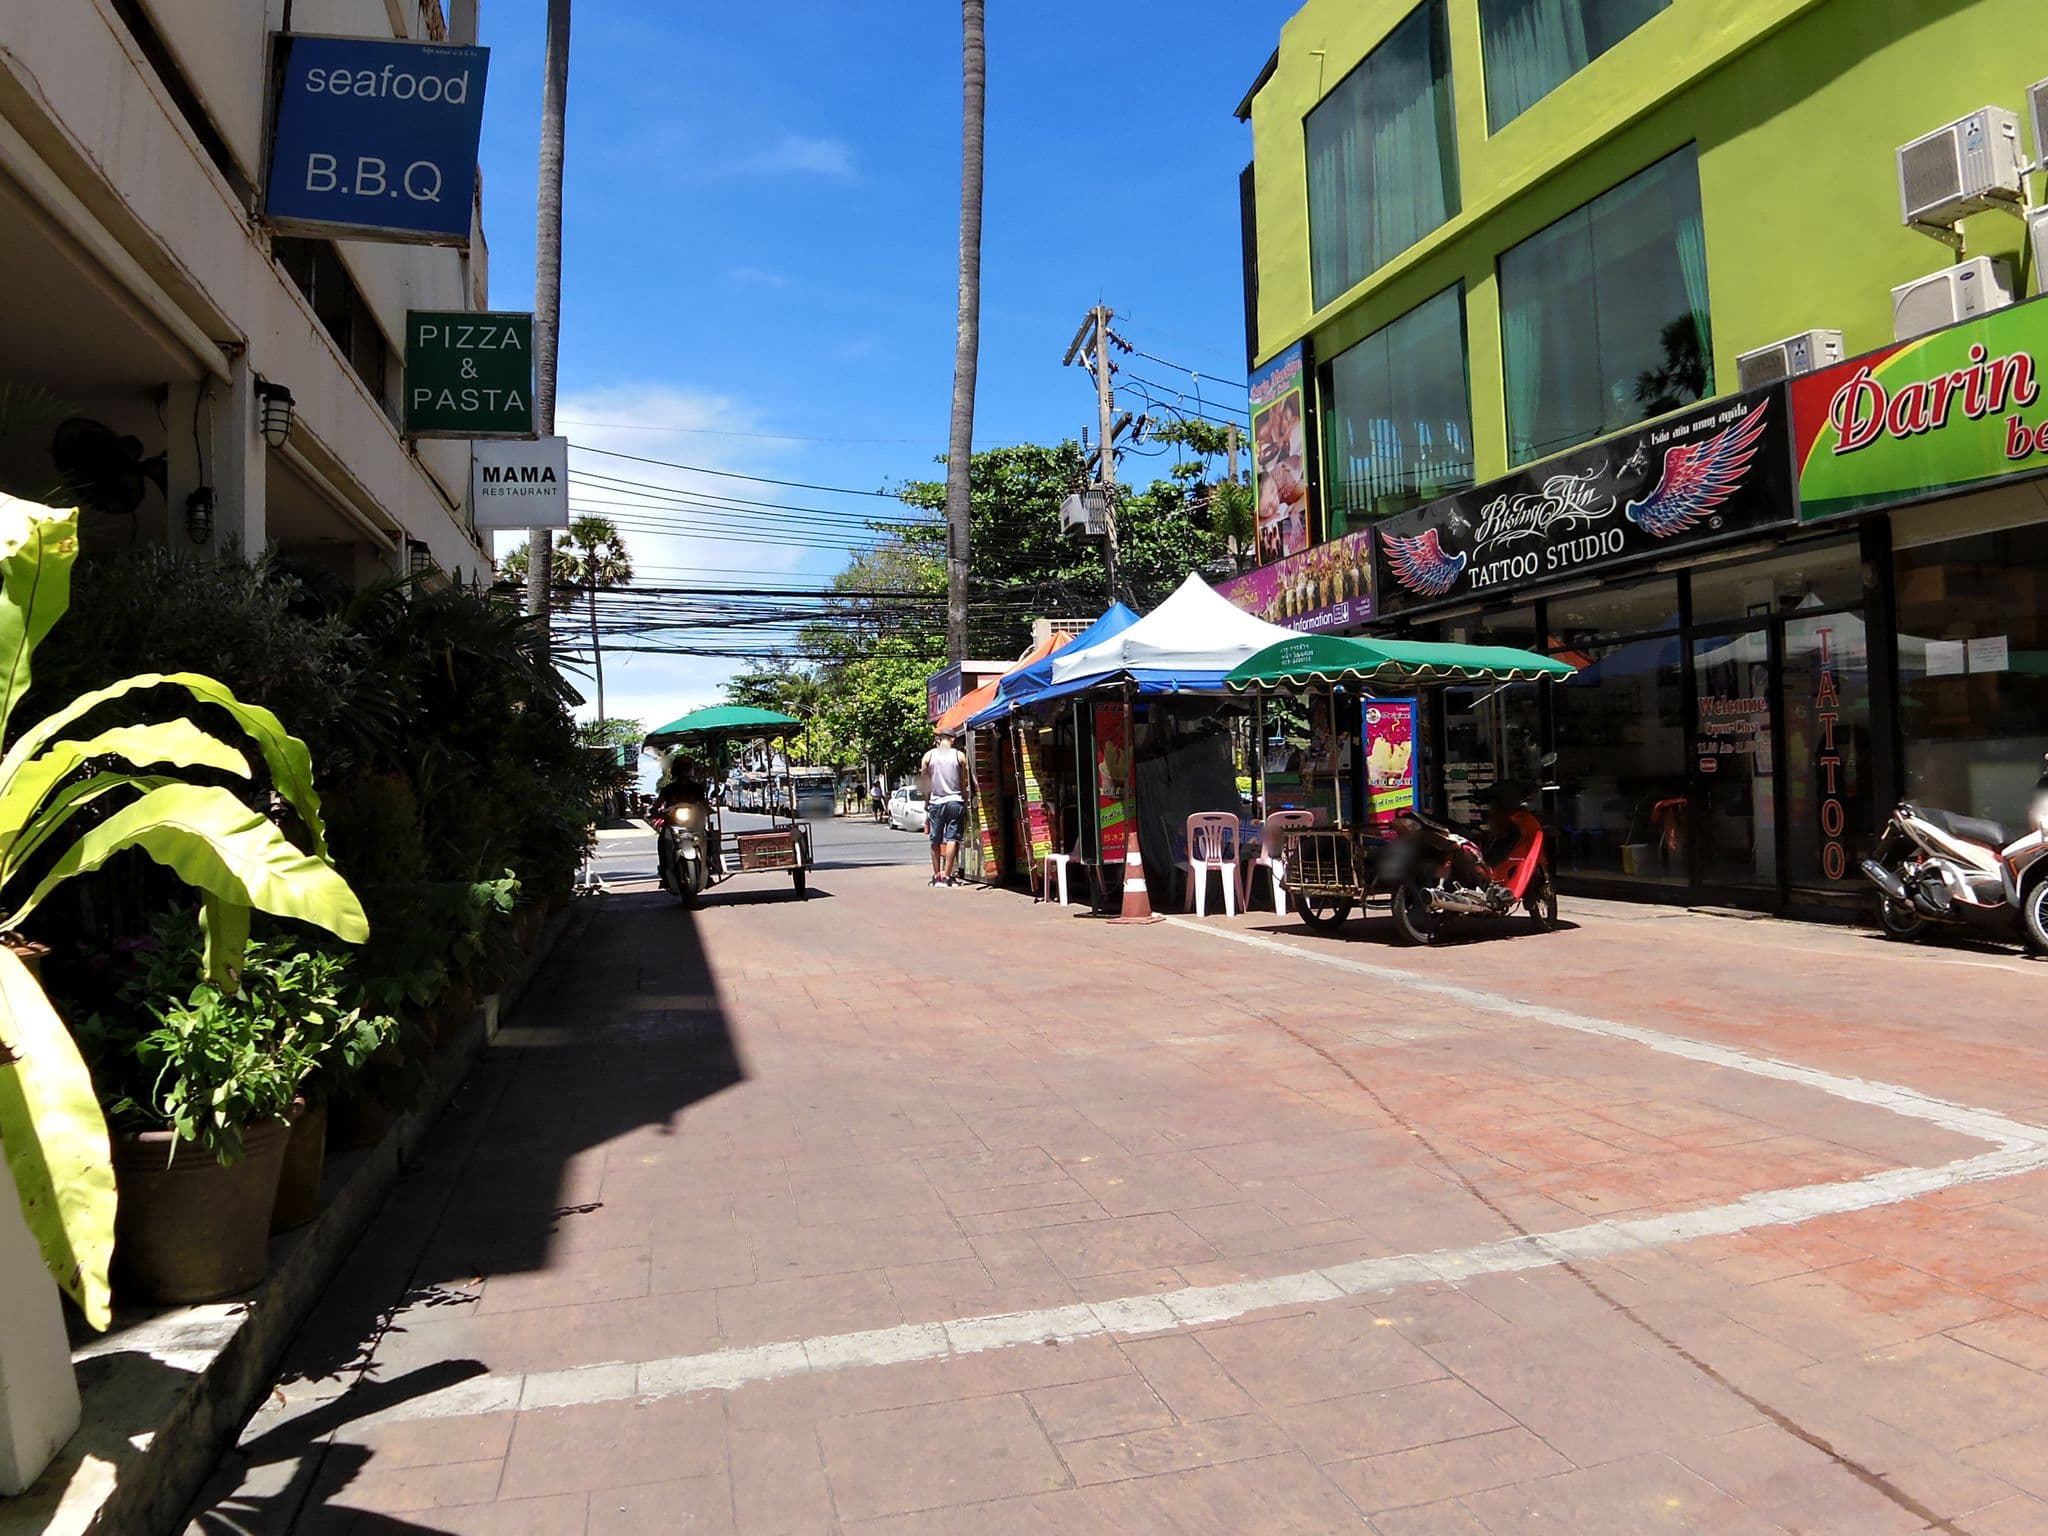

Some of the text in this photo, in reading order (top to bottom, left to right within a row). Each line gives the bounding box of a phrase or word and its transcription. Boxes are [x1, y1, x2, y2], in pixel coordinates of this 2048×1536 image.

[306, 64, 469, 104] seafood
[305, 153, 443, 203] B.B.Q
[419, 325, 522, 350] PIZZA
[460, 357, 479, 379] &
[414, 388, 526, 412] PASTA
[1829, 344, 2036, 453] Darin
[482, 466, 557, 483] MAMA
[482, 487, 558, 496] RESTAURANT
[1474, 494, 1550, 550] Rising
[1468, 528, 1624, 589] TATTOO STUDIO
[1293, 611, 1333, 632] Information
[1697, 695, 1767, 716] Welcome
[1815, 628, 1845, 880] TATTOO
